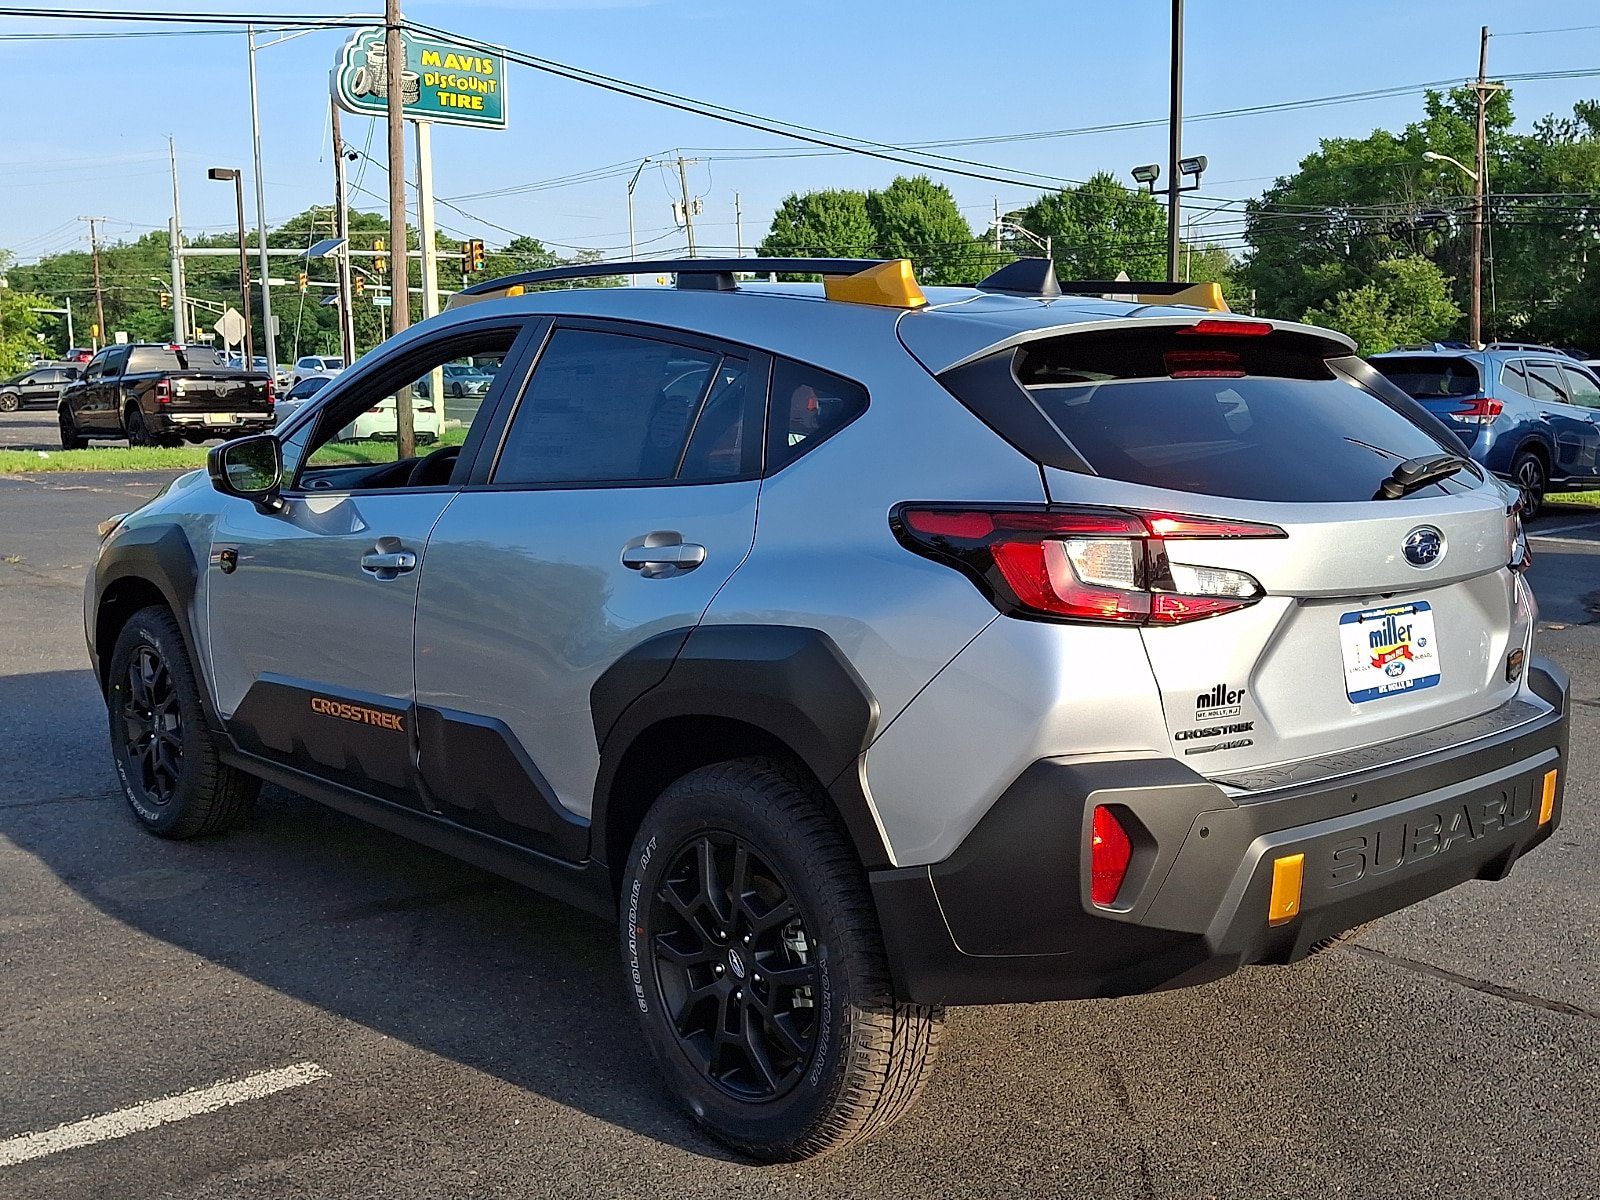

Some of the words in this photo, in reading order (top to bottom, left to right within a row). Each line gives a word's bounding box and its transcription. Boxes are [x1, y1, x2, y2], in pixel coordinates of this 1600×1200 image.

[421, 49, 494, 75] MAVIS
[424, 71, 497, 94] DISCOUNT
[437, 91, 484, 110] TIRE
[1369, 615, 1413, 648] miller
[1196, 683, 1246, 709] miller
[312, 697, 404, 732] CROSSTREK
[1175, 721, 1254, 741] CROSSTREK
[1327, 779, 1535, 889] SUBARU
[628, 879, 648, 1014] GEOLANDAR
[640, 836, 657, 871] A/T
[810, 958, 832, 1087] YOKOHAMA
